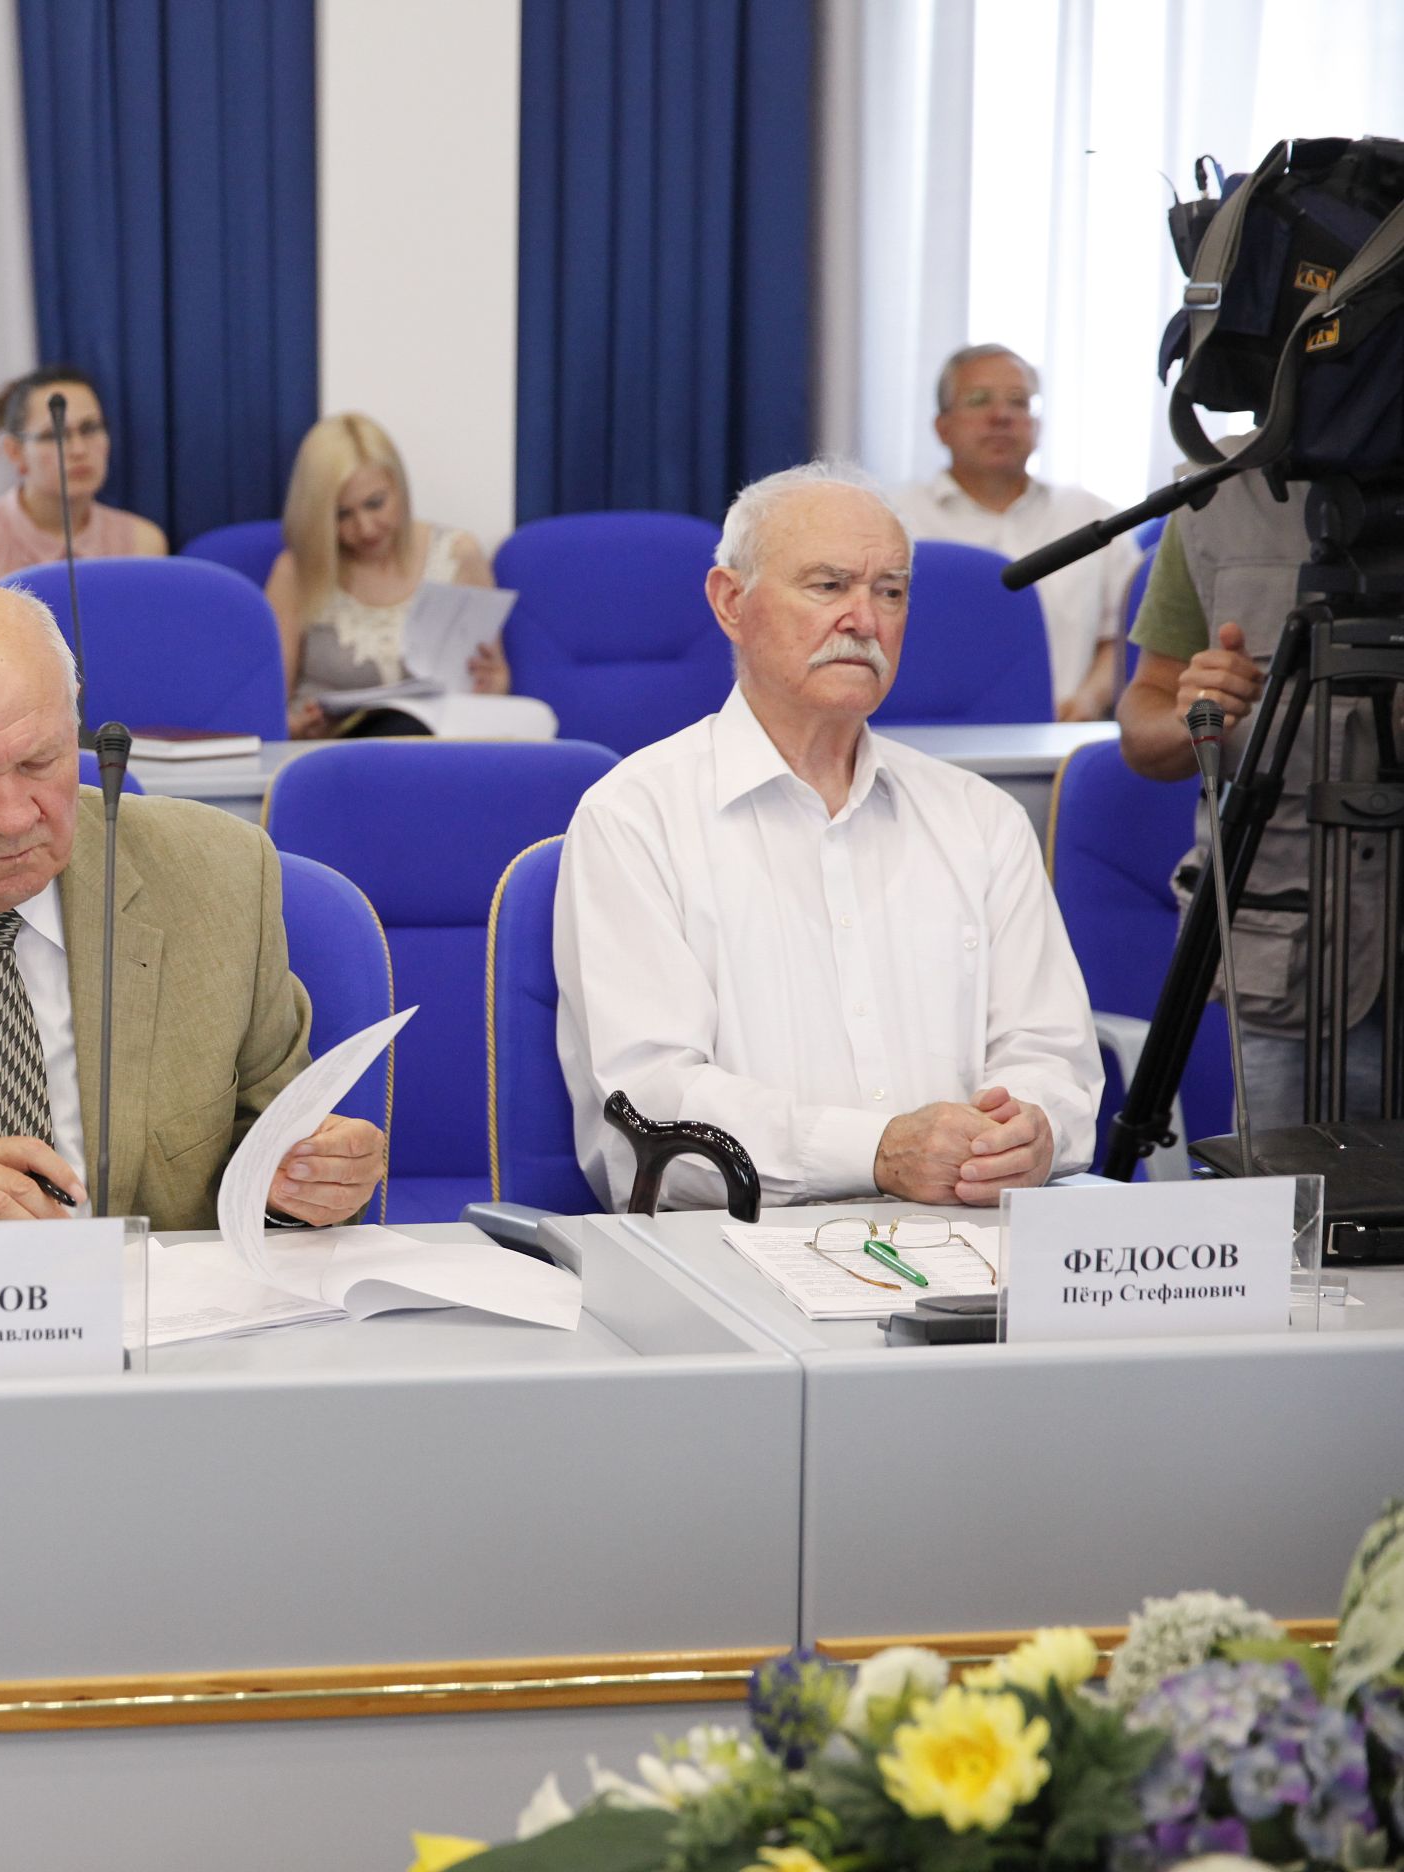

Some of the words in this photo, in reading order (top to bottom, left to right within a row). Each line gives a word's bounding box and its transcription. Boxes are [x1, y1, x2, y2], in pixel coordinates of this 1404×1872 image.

[1063, 1243, 1238, 1277] ФЕДОСОВ
[1062, 1285, 1113, 1307] Пётр
[1119, 1283, 1246, 1304] Стефанович
